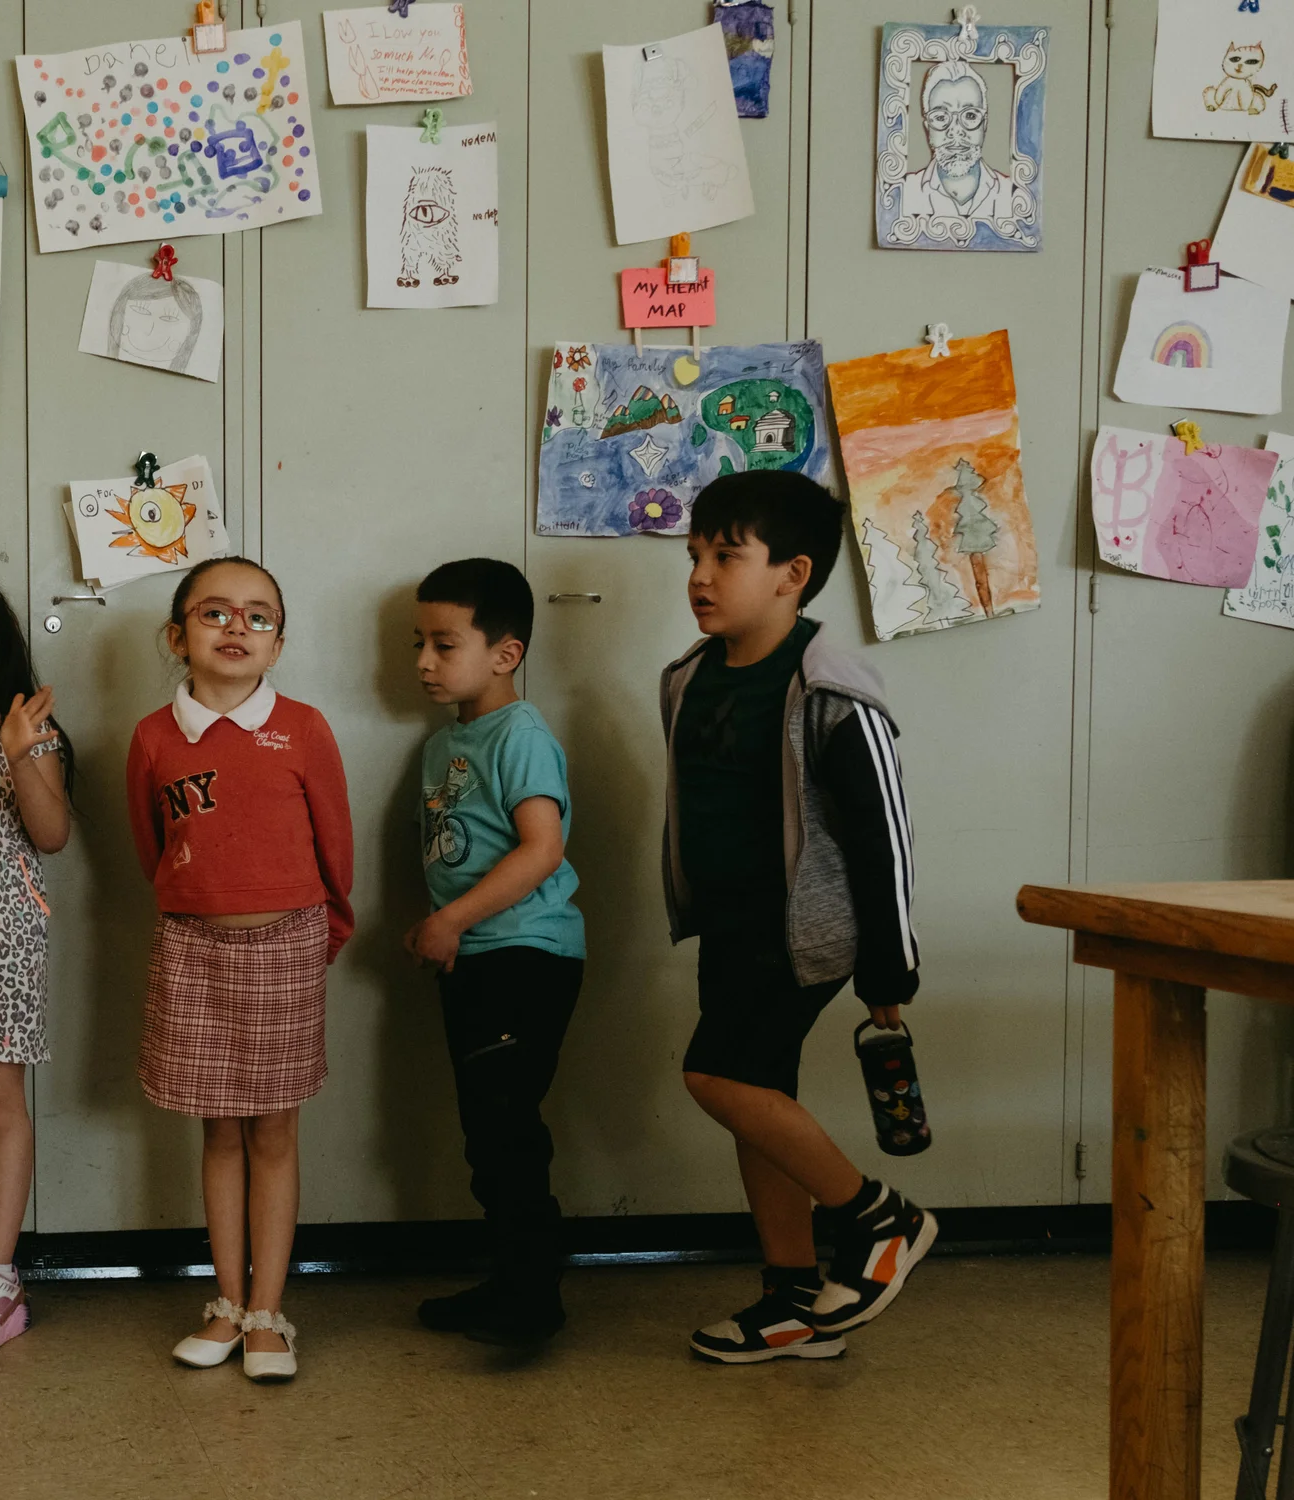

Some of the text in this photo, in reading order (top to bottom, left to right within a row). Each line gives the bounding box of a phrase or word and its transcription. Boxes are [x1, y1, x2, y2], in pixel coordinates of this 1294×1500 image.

[384, 51, 414, 61] much
[396, 67, 414, 76] help
[391, 78, 410, 86] your
[647, 303, 686, 319] MAP
[253, 729, 291, 742] East Coast
[256, 737, 284, 750] Champs
[163, 769, 218, 823] NY
